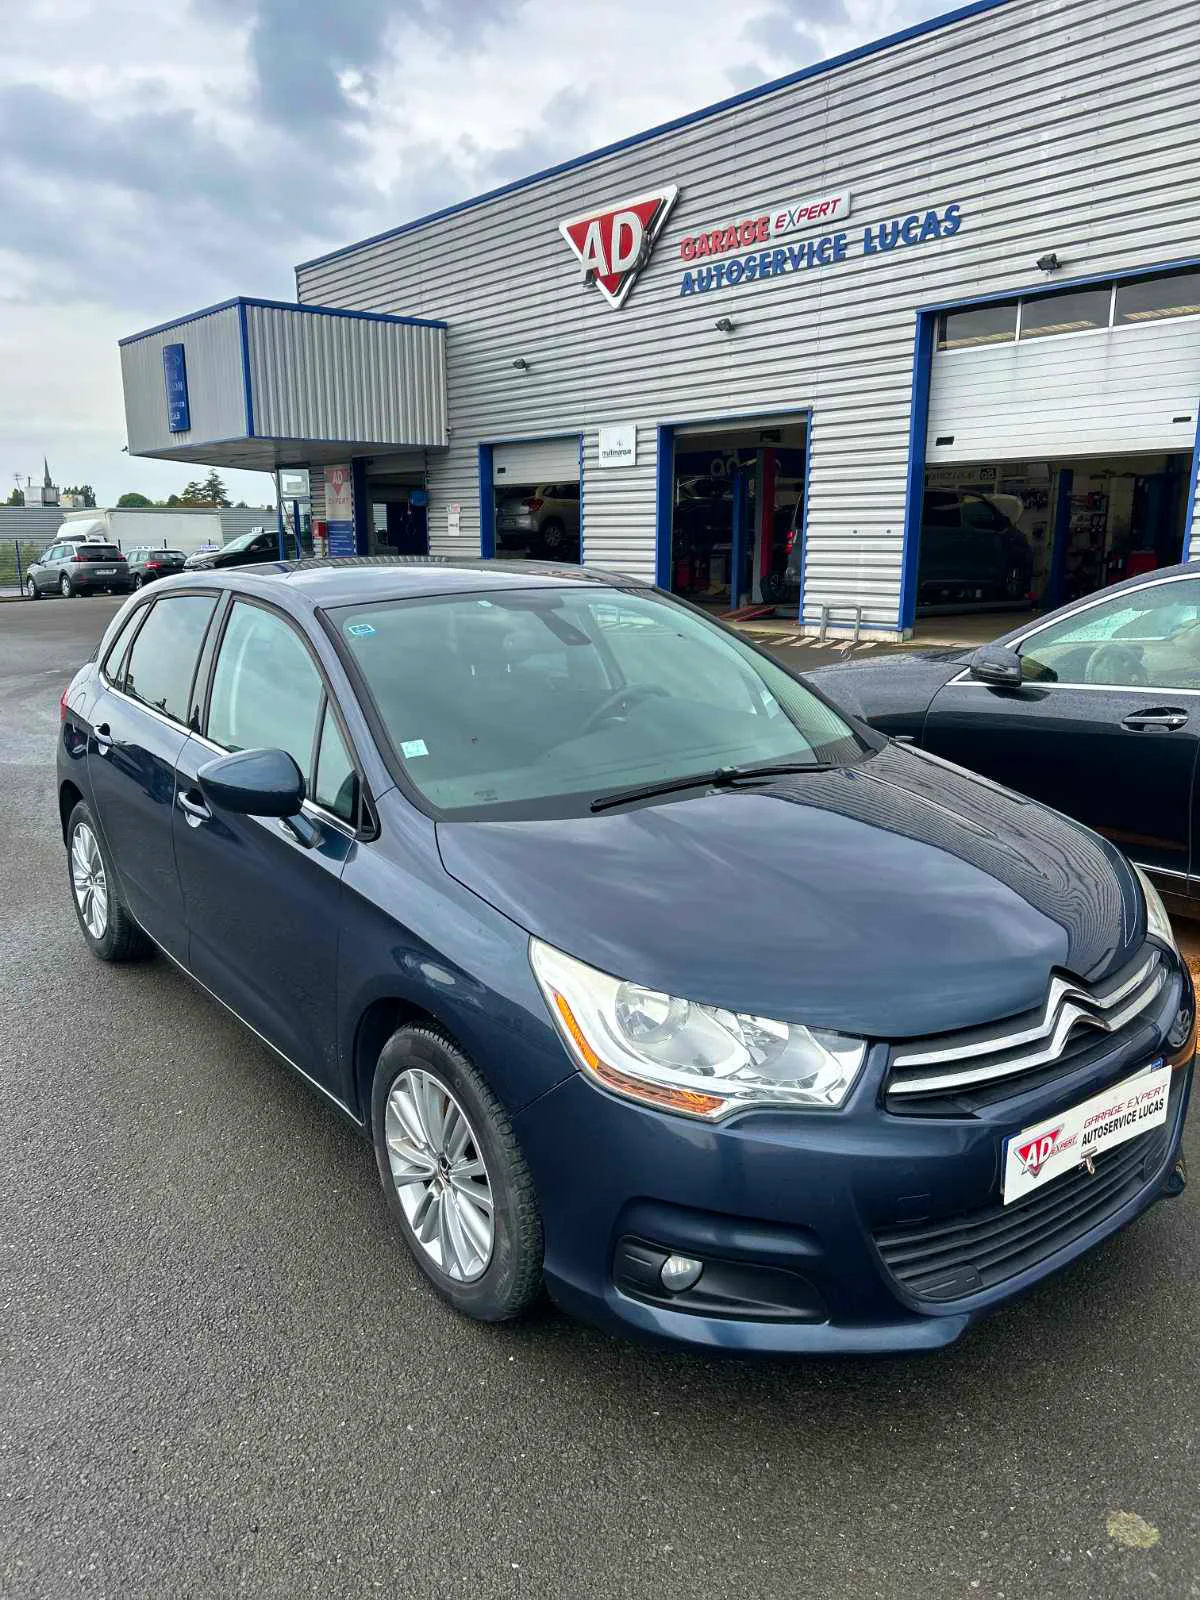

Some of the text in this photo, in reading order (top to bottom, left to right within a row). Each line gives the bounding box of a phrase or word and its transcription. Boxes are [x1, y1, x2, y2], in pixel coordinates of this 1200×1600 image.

[581, 211, 643, 283] AD
[679, 216, 771, 262] GARAGE
[680, 204, 961, 297] AUTOSERVICE LUCAS
[1081, 1098, 1164, 1147] AUTOSERVICE LUCAS
[1083, 1084, 1168, 1129] GARAGE EXPERT
[1021, 1135, 1053, 1175] AD
